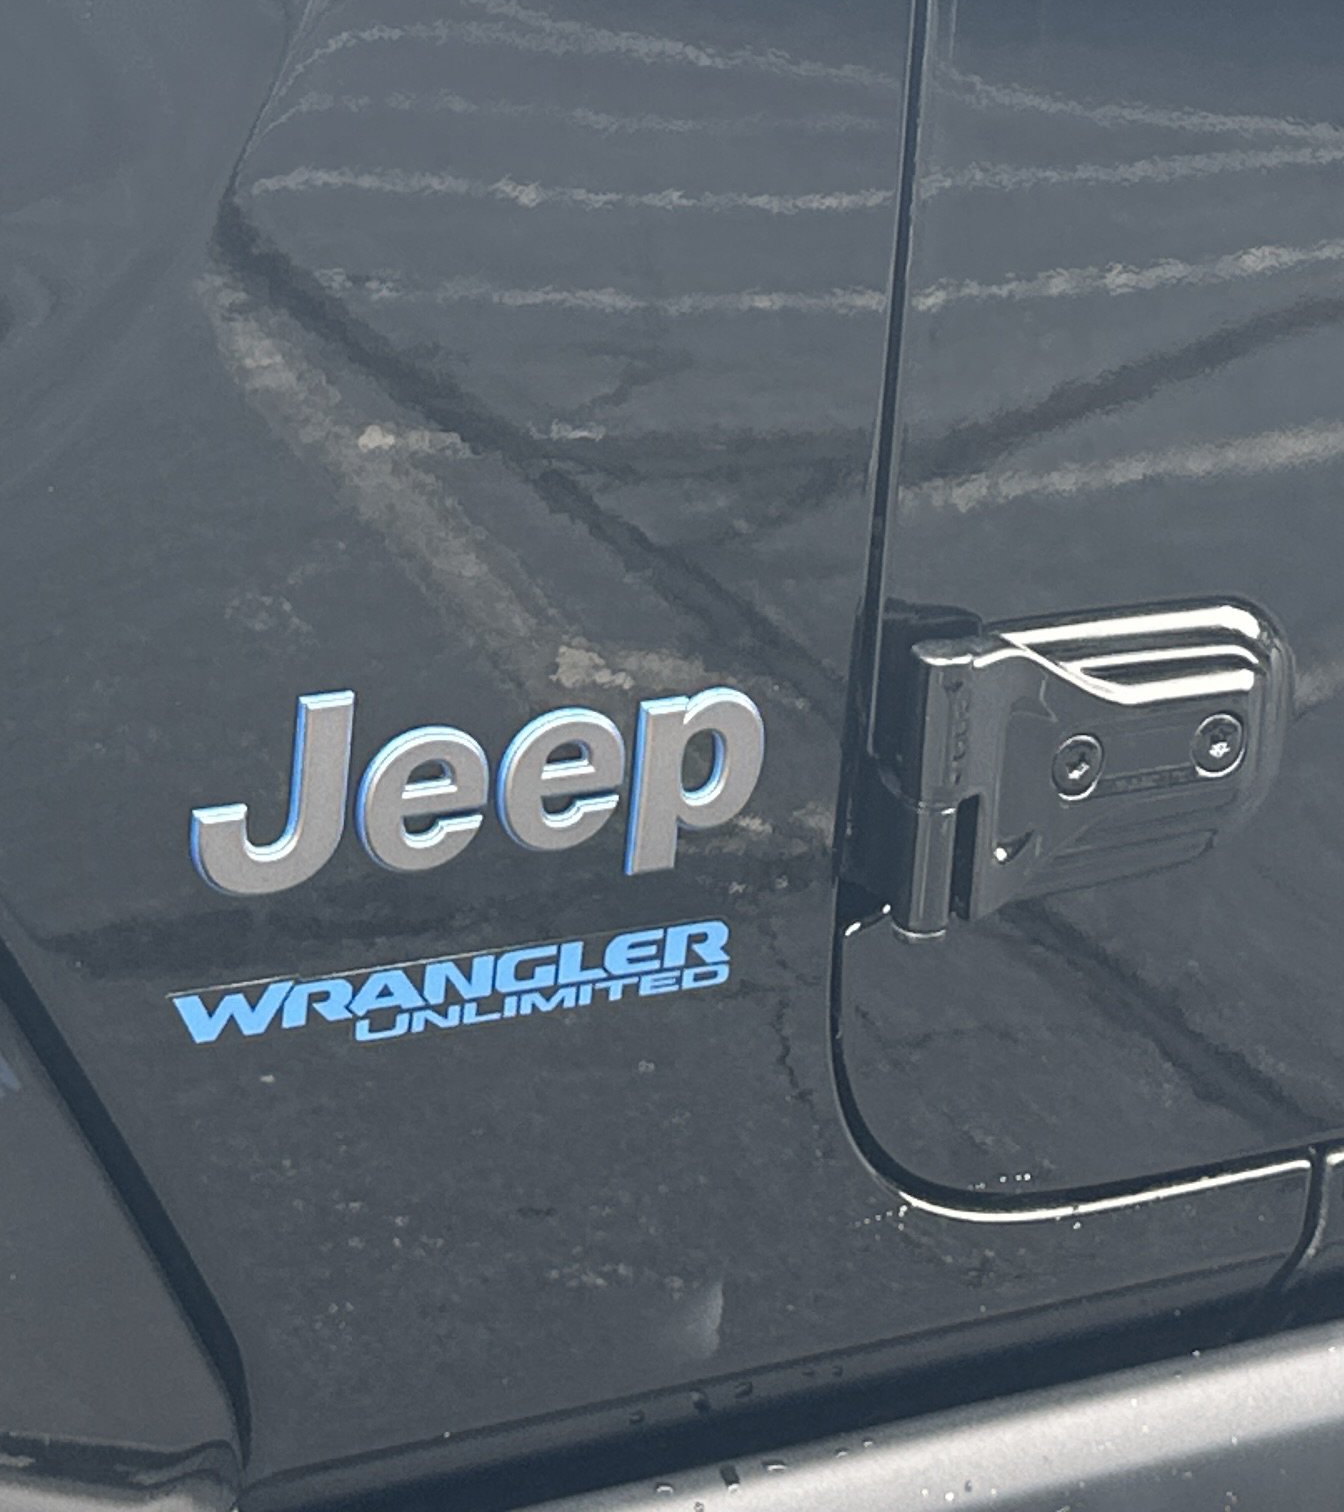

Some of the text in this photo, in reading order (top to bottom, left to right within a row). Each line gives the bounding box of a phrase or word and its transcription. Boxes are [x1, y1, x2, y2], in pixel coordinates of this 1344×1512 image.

[191, 686, 765, 896] Jeep
[172, 919, 731, 1045] WRANGLER
[355, 963, 731, 1043] UNLIMITED
